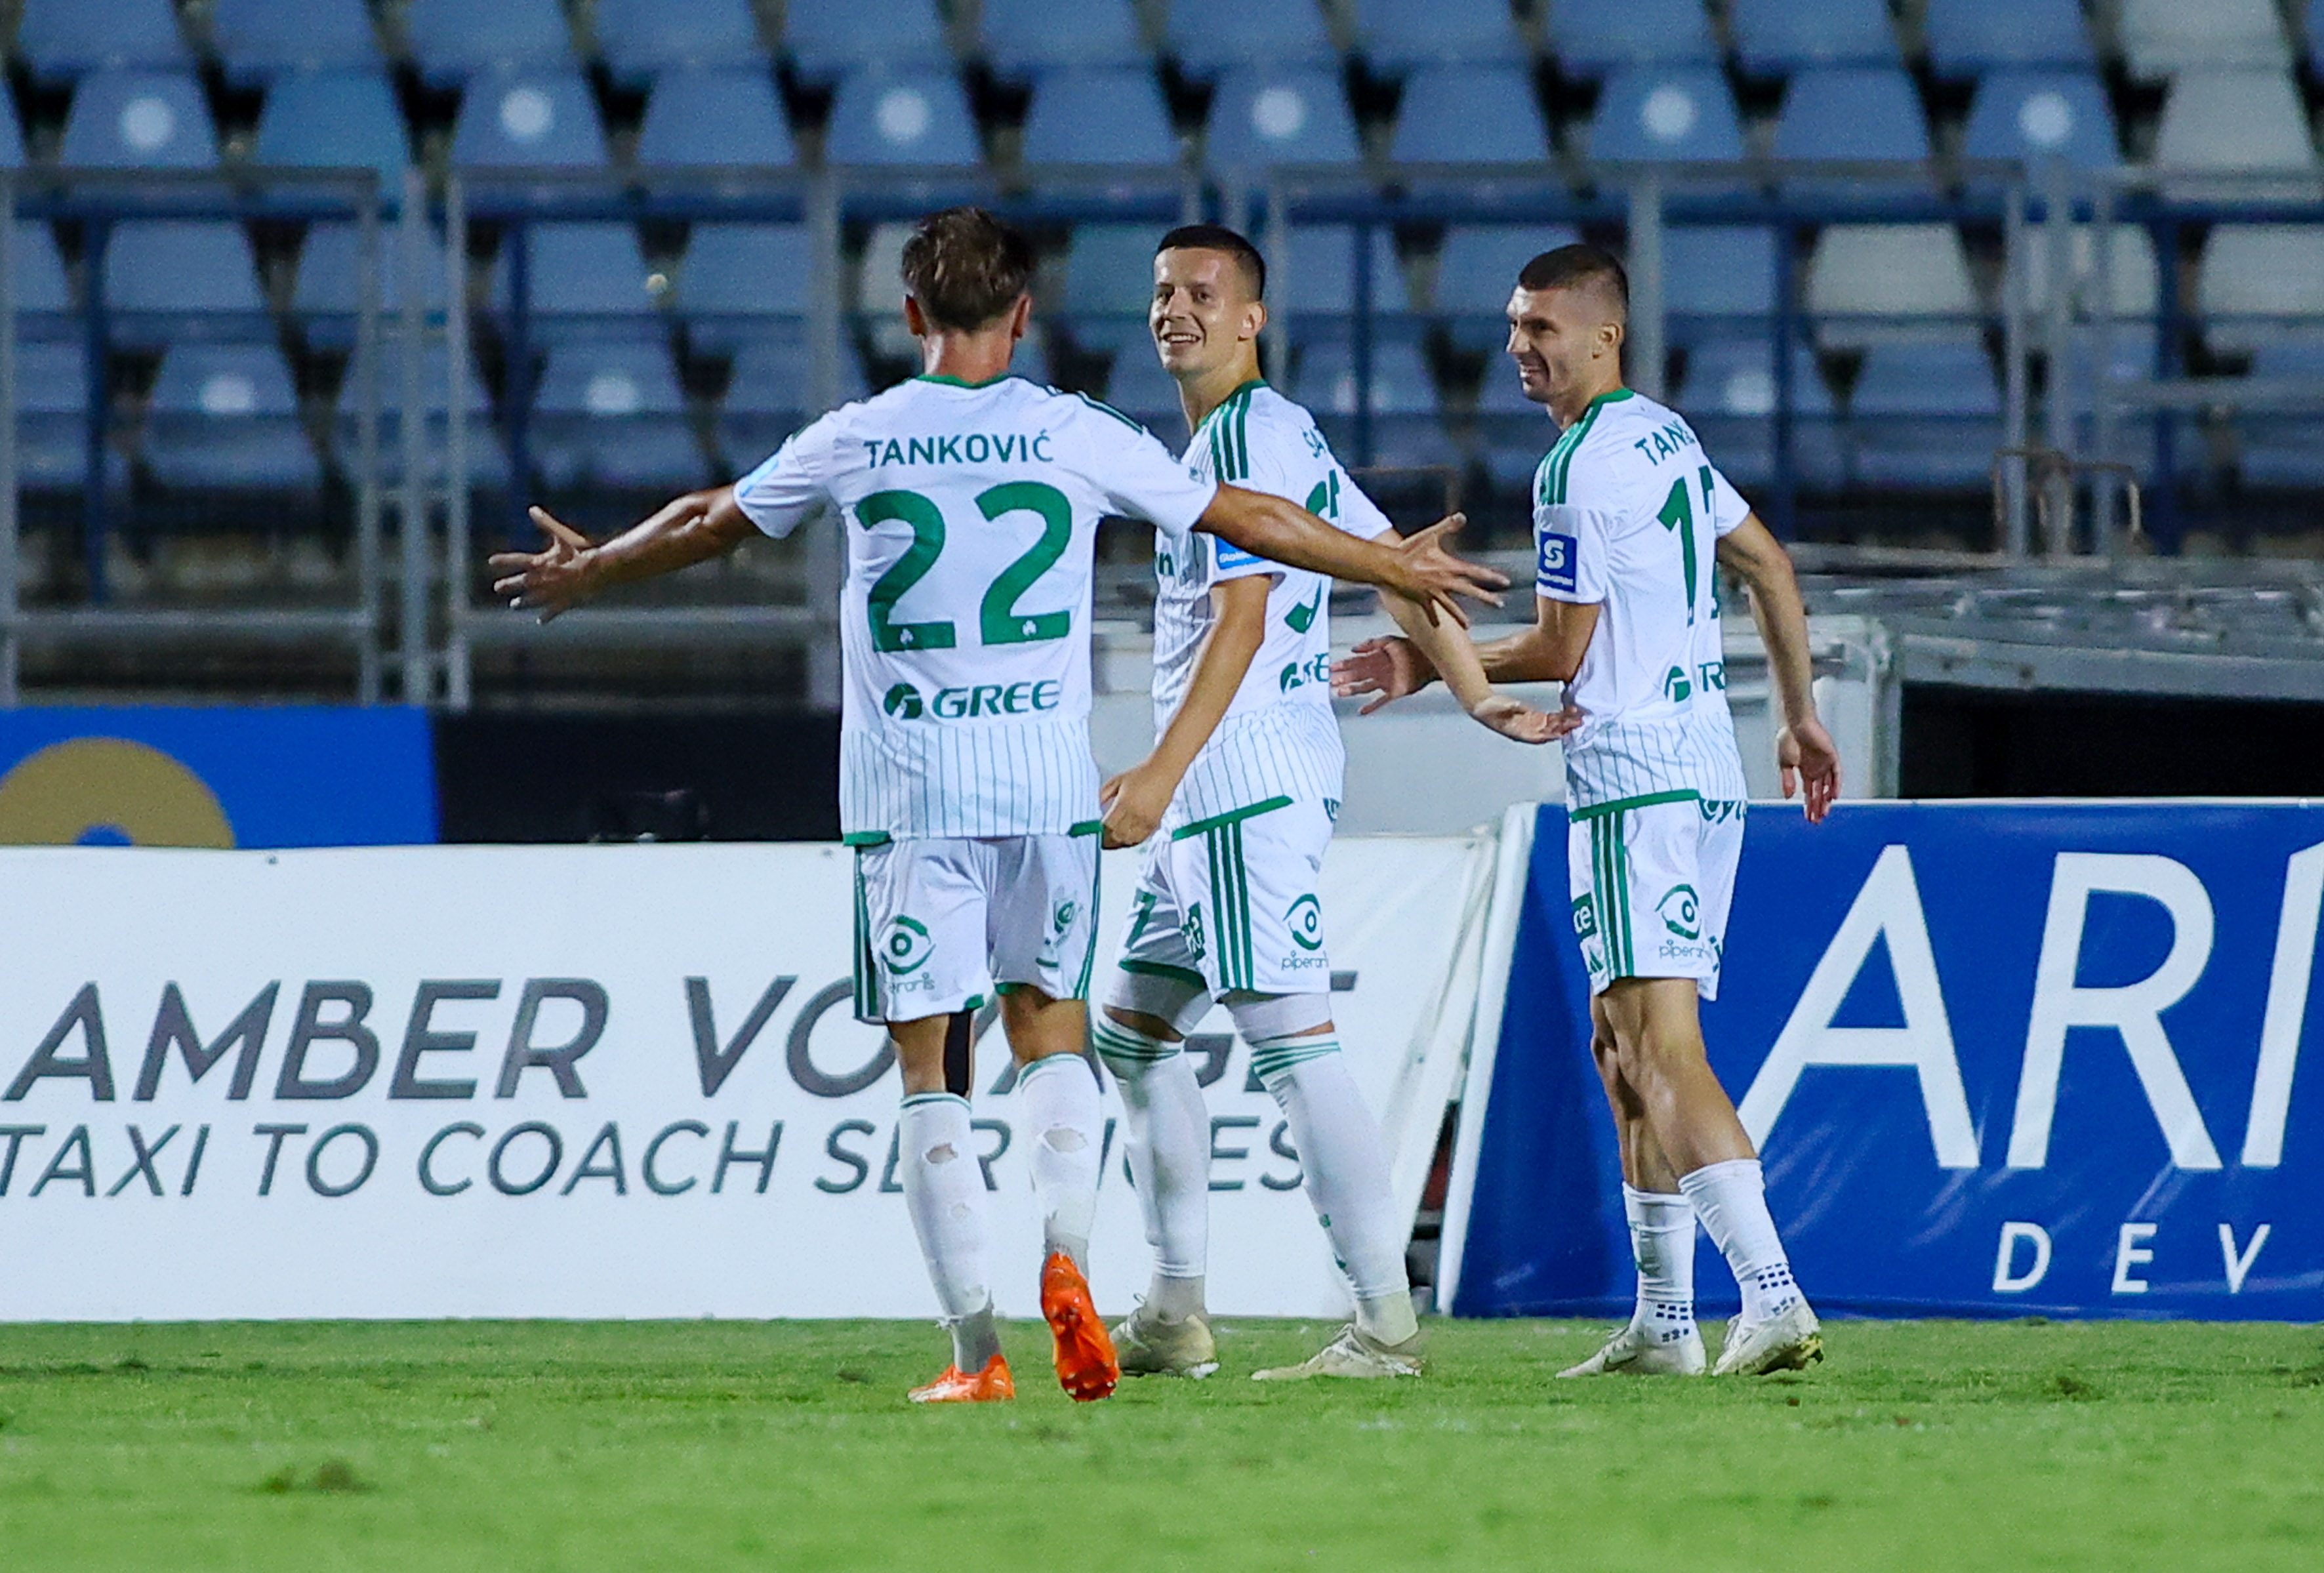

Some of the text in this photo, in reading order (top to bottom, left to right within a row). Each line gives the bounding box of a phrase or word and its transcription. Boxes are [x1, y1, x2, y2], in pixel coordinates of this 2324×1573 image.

[864, 429, 1053, 469] TANKOVIĆ
[855, 480, 1072, 653] 22
[933, 680, 1060, 718] GREE
[1, 977, 610, 1102] AMBER
[0, 1123, 211, 1197] TAXI
[254, 1122, 380, 1198] TO
[417, 1121, 785, 1196] COACH
[1991, 1221, 2272, 1294] DEV
